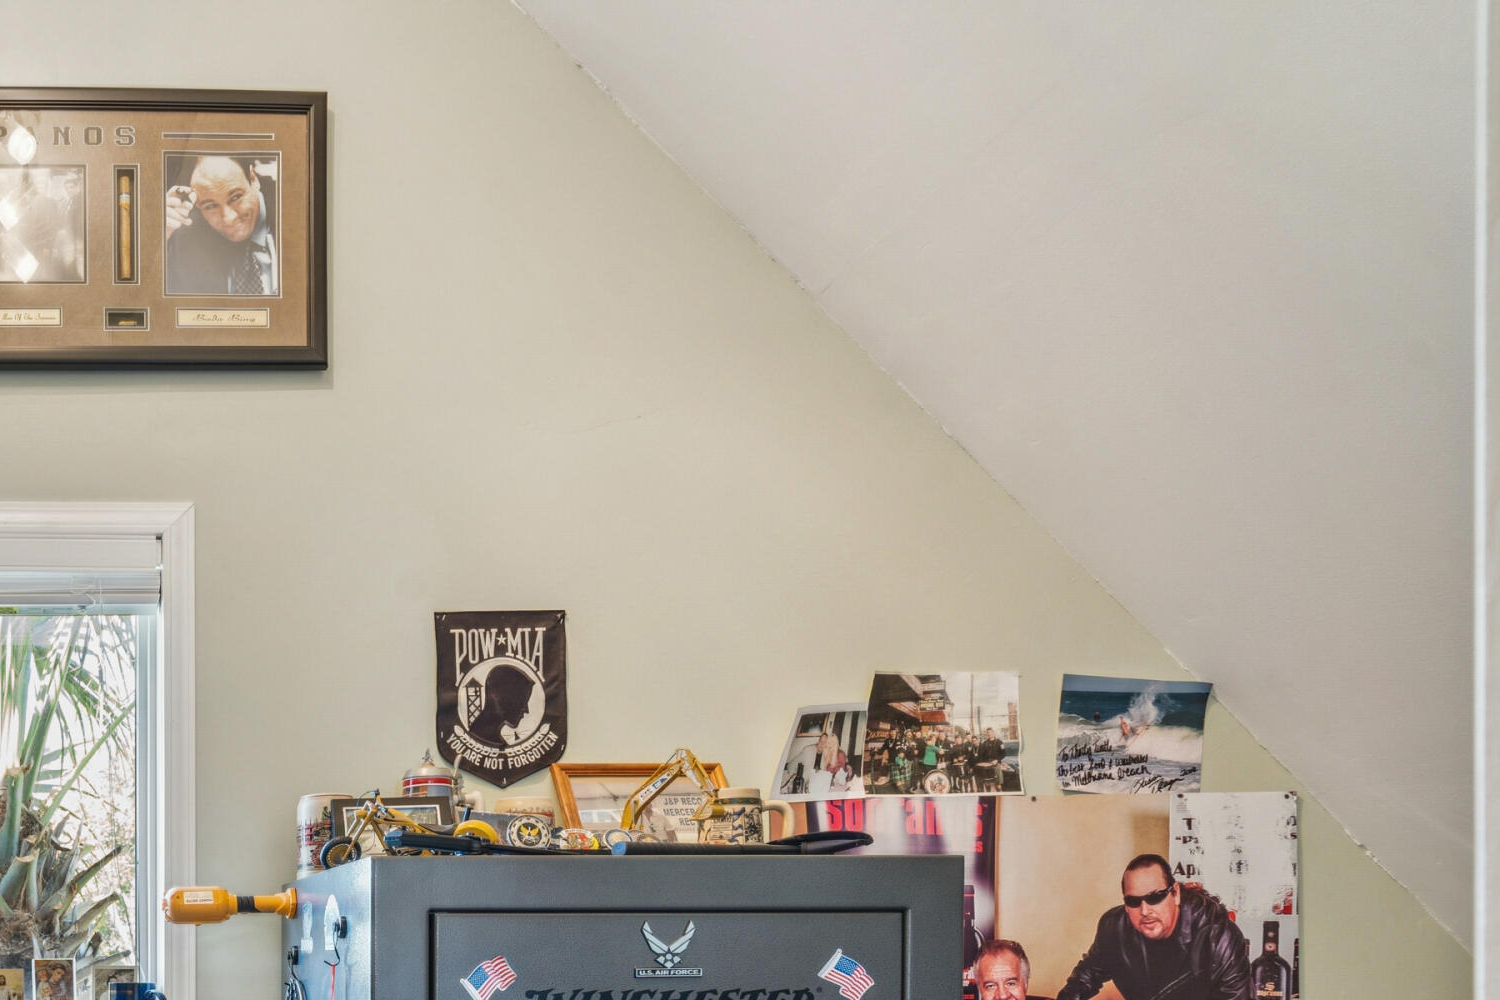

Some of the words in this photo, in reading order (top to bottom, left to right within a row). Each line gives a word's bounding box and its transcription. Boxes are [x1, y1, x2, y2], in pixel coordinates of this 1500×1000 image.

[450, 628, 498, 687] POW
[505, 627, 546, 682] MIA
[446, 733, 465, 754] YOU
[463, 750, 480, 765] ARE
[484, 758, 503, 770] NOT
[508, 731, 559, 769] FORGOTTEN
